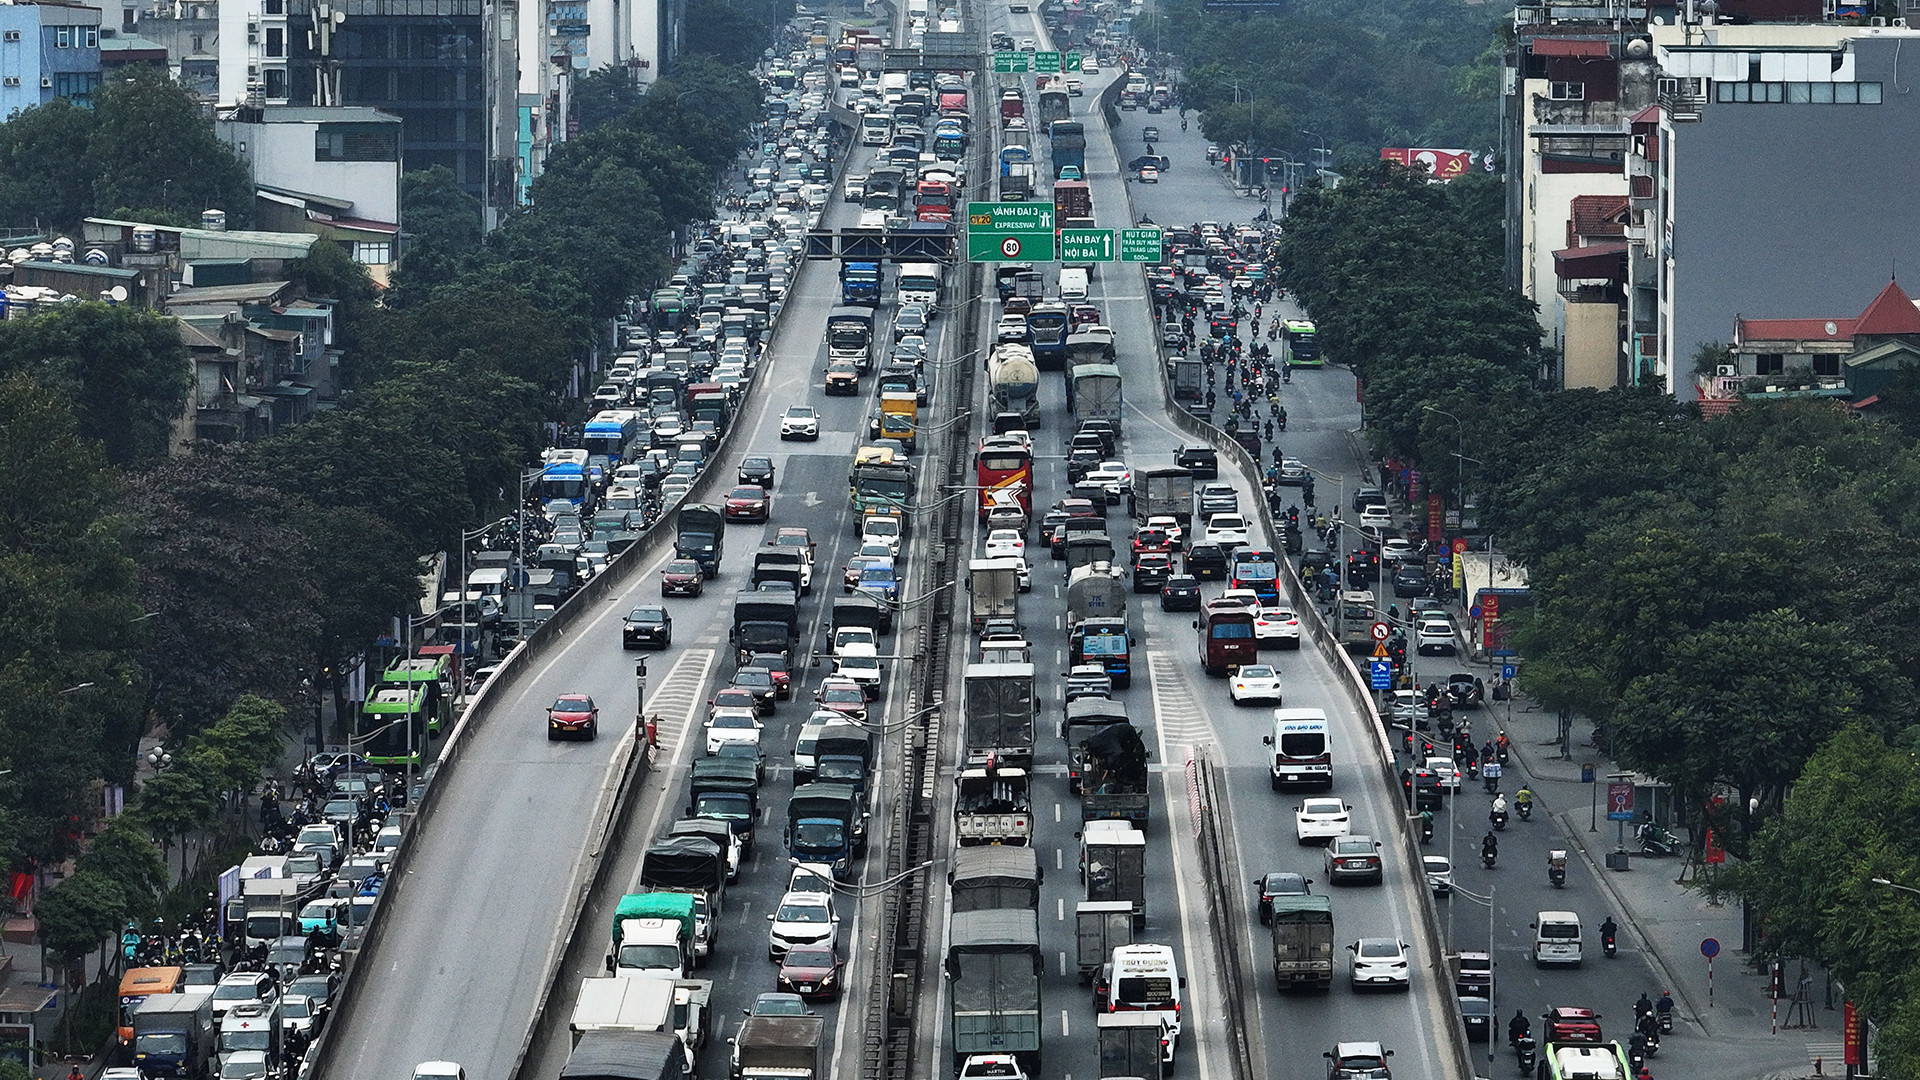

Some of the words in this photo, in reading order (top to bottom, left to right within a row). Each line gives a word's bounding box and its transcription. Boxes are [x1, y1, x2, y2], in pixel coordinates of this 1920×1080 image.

[993, 206, 1015, 215] VÀNH
[1033, 207, 1038, 215] 3
[1005, 242, 1018, 252] 80
[1064, 247, 1080, 258] NỘI
[1082, 247, 1098, 257] BÀI
